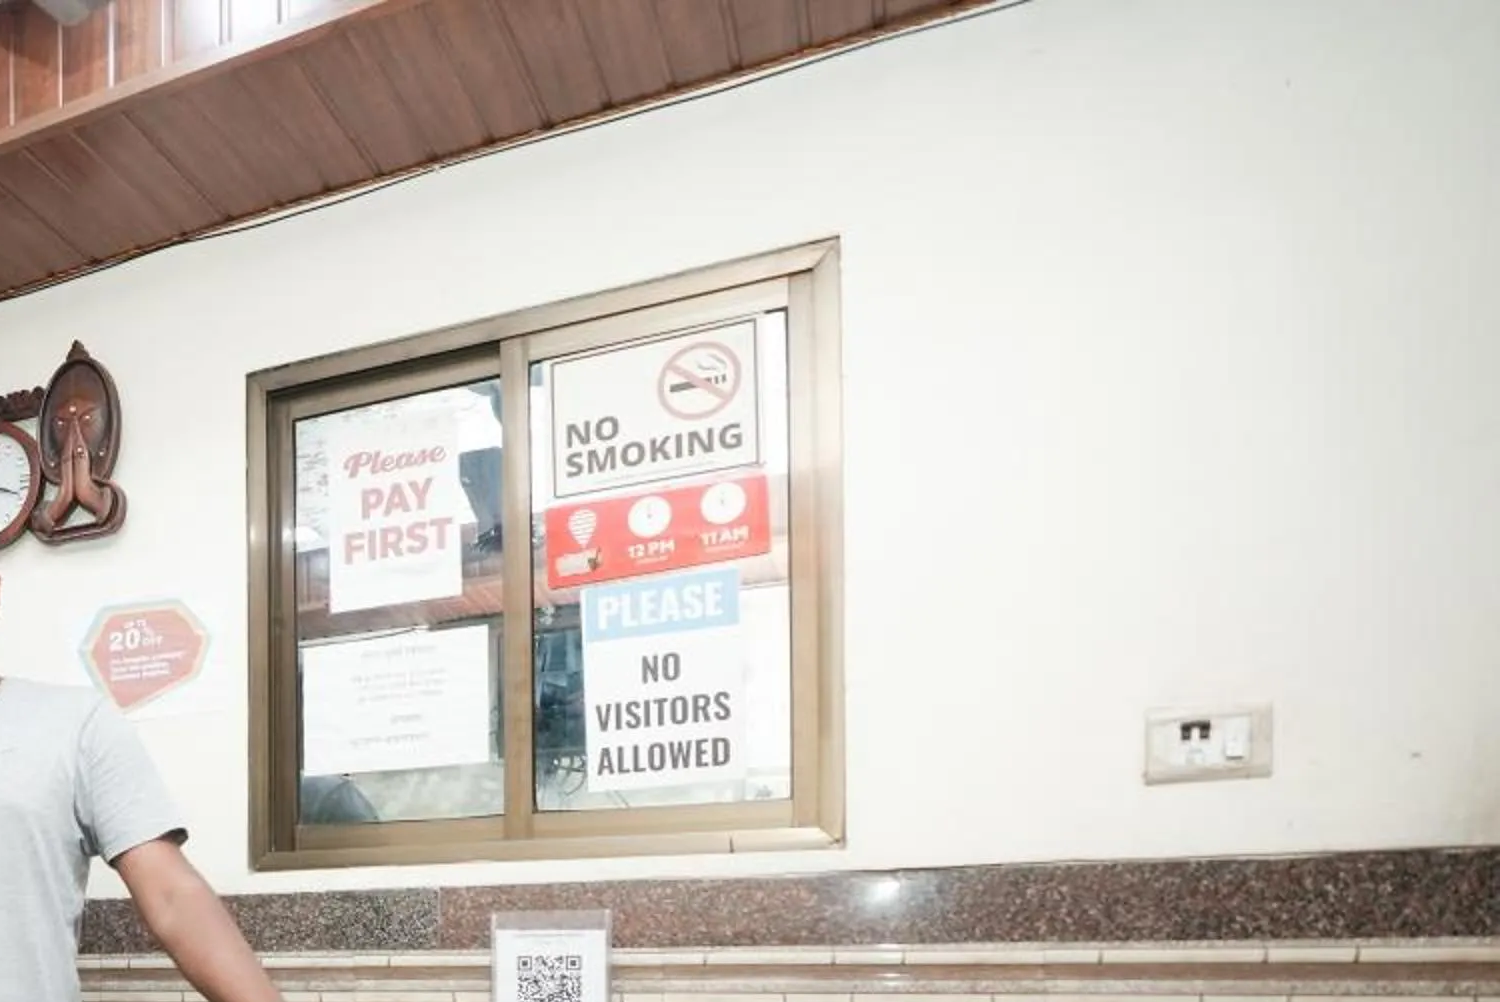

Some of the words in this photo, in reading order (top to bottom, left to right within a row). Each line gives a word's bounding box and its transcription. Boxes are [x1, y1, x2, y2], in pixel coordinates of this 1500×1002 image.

[566, 415, 619, 449] NO
[566, 422, 743, 478] SMOKING
[343, 445, 447, 479] Please
[361, 477, 434, 520] PAY
[344, 517, 453, 565] FIRST
[627, 545, 646, 558] 12
[648, 538, 676, 555] PM
[719, 525, 750, 543] AM
[598, 581, 724, 631] PLEASE
[642, 652, 681, 684] NO
[596, 691, 731, 732] VISITORS
[597, 737, 731, 776] ALLOWED
